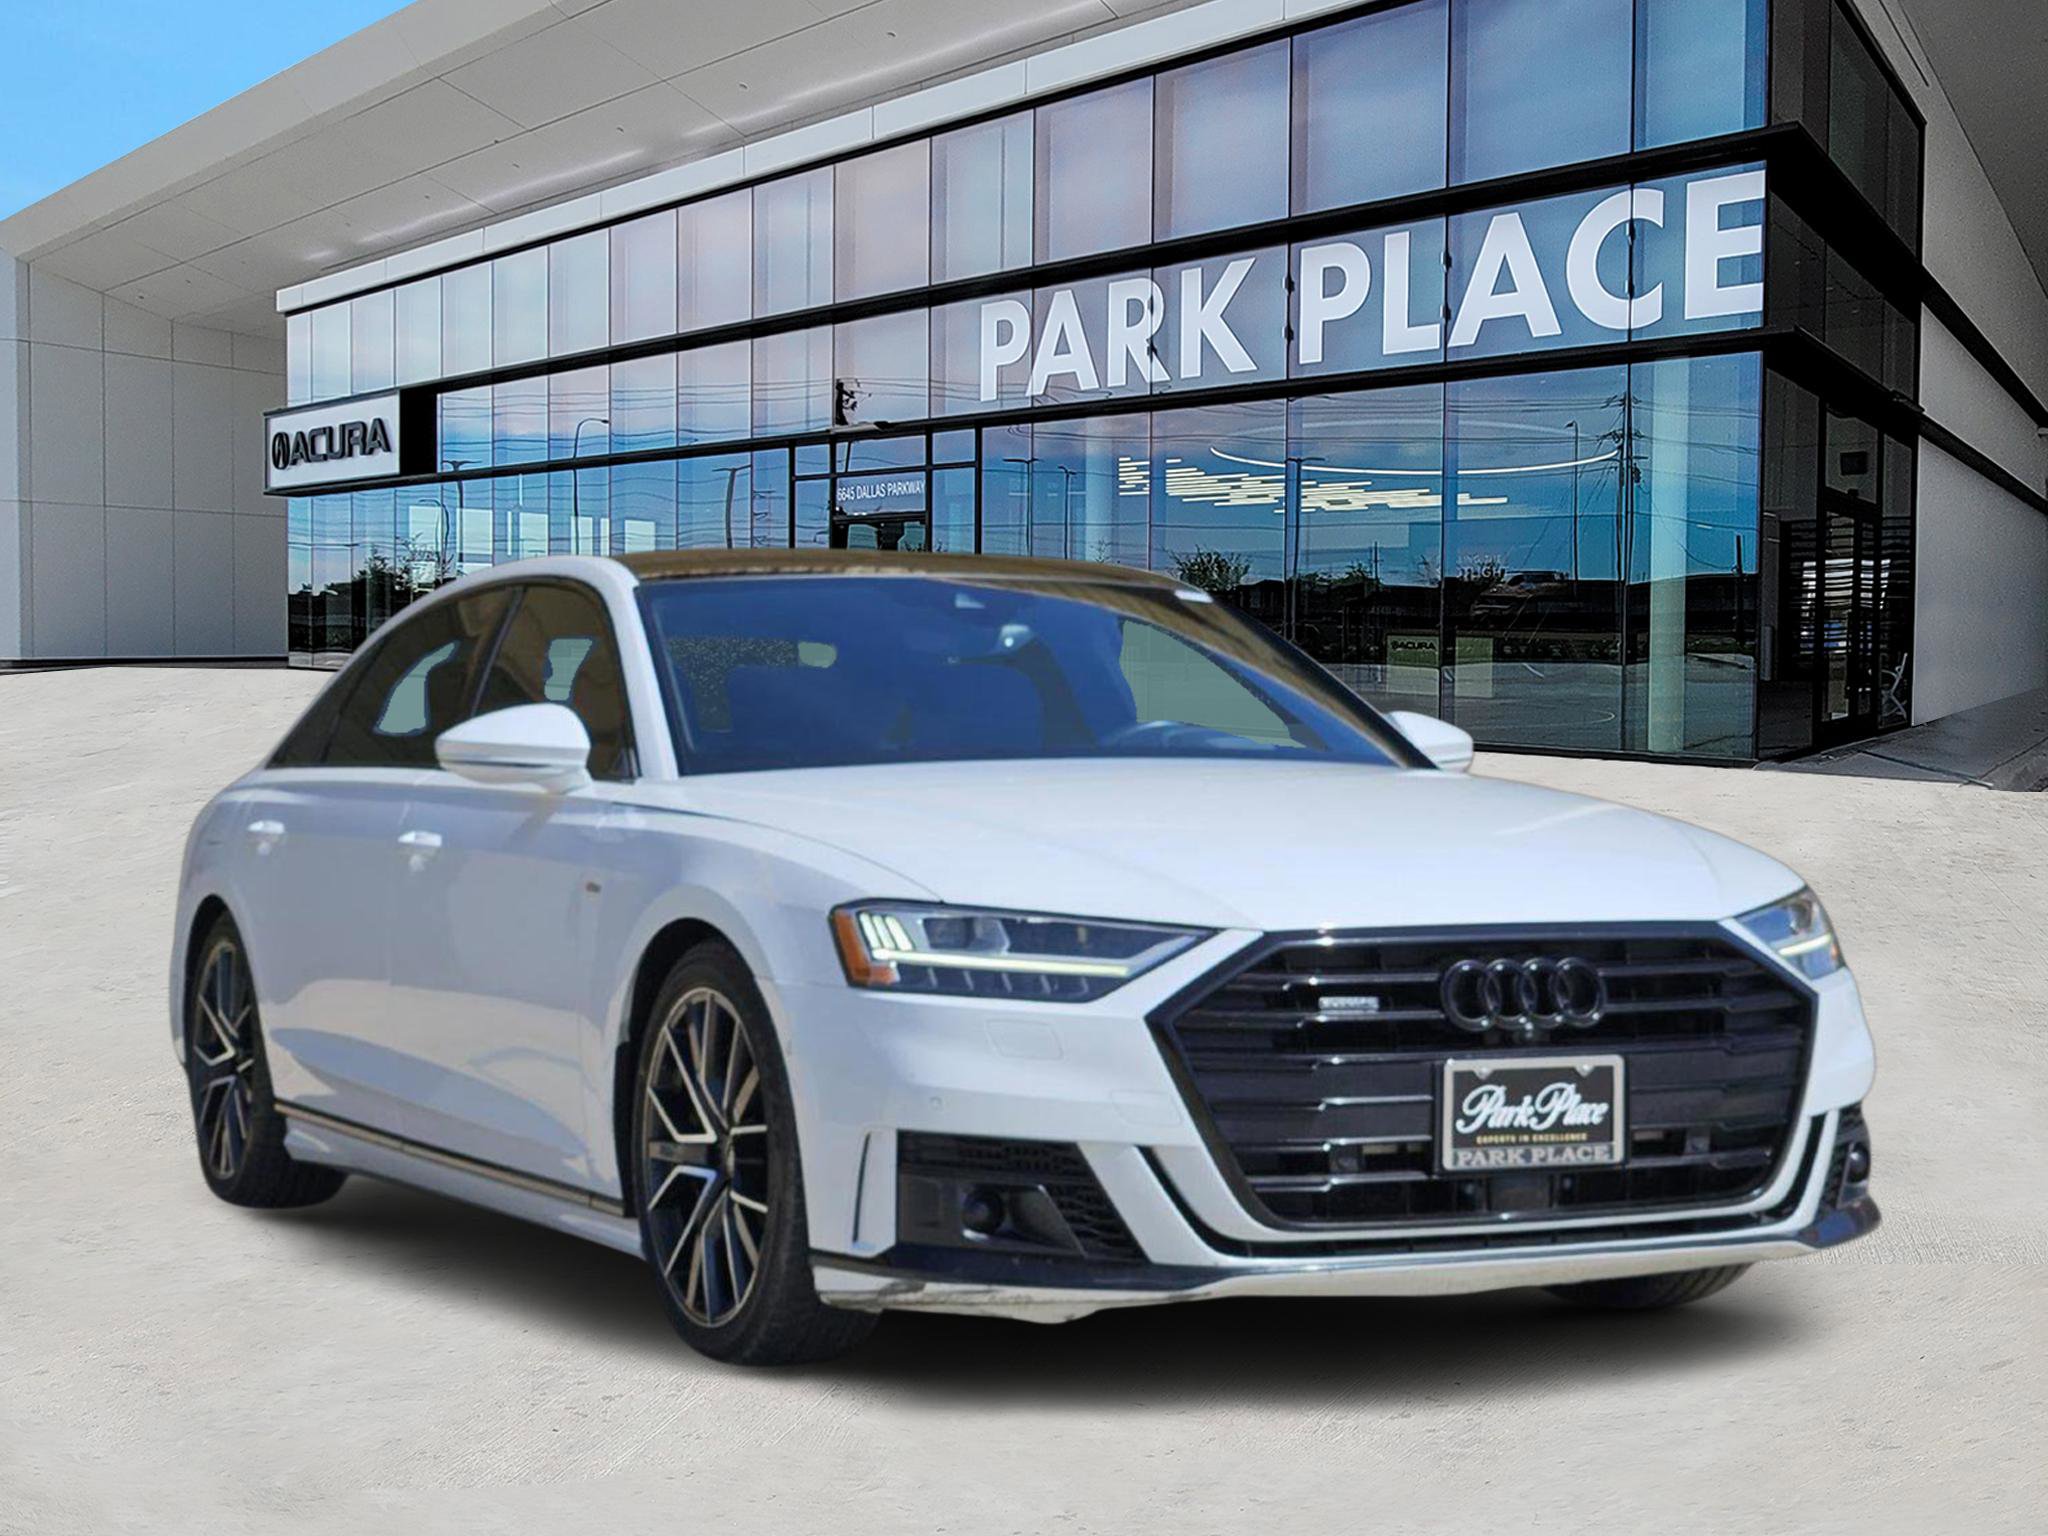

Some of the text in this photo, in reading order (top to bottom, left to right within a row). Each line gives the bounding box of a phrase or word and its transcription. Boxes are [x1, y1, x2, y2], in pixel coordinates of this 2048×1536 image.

[977, 168, 1766, 402] PARK PLACE
[289, 417, 392, 466] ACURA
[856, 483, 886, 500] DALLAS
[887, 480, 925, 497] PARKWAY
[1399, 641, 1437, 651] ACURA
[1456, 1082, 1609, 1133] Park Place
[1457, 1145, 1611, 1168] PARK PLACE
